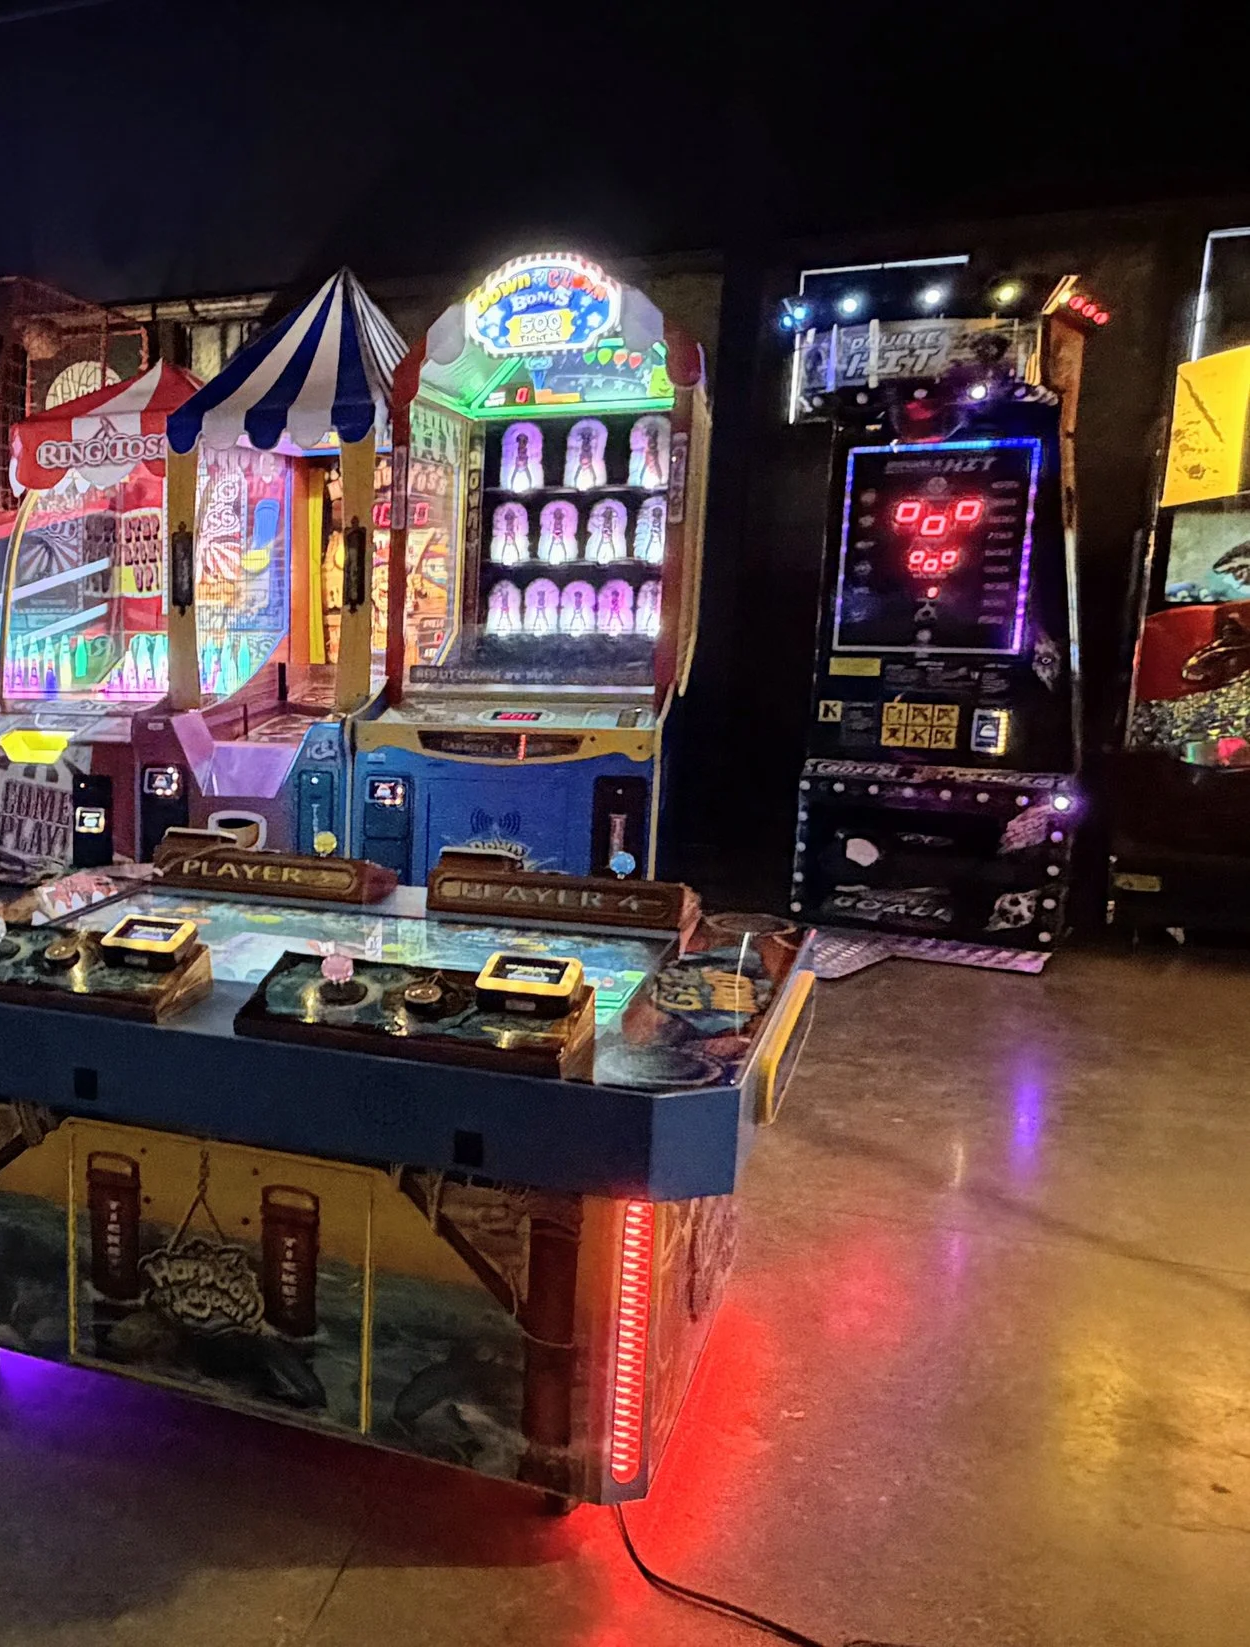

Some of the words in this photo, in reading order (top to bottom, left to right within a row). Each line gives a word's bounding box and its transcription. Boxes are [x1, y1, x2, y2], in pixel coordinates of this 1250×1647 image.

[520, 313, 562, 334] 500
[846, 348, 941, 377] HIT
[38, 443, 105, 467] RING
[181, 860, 302, 883] PLAYER
[461, 880, 602, 908] PLAYER
[619, 896, 639, 912] 4
[150, 1253, 258, 1320] Harpoon
